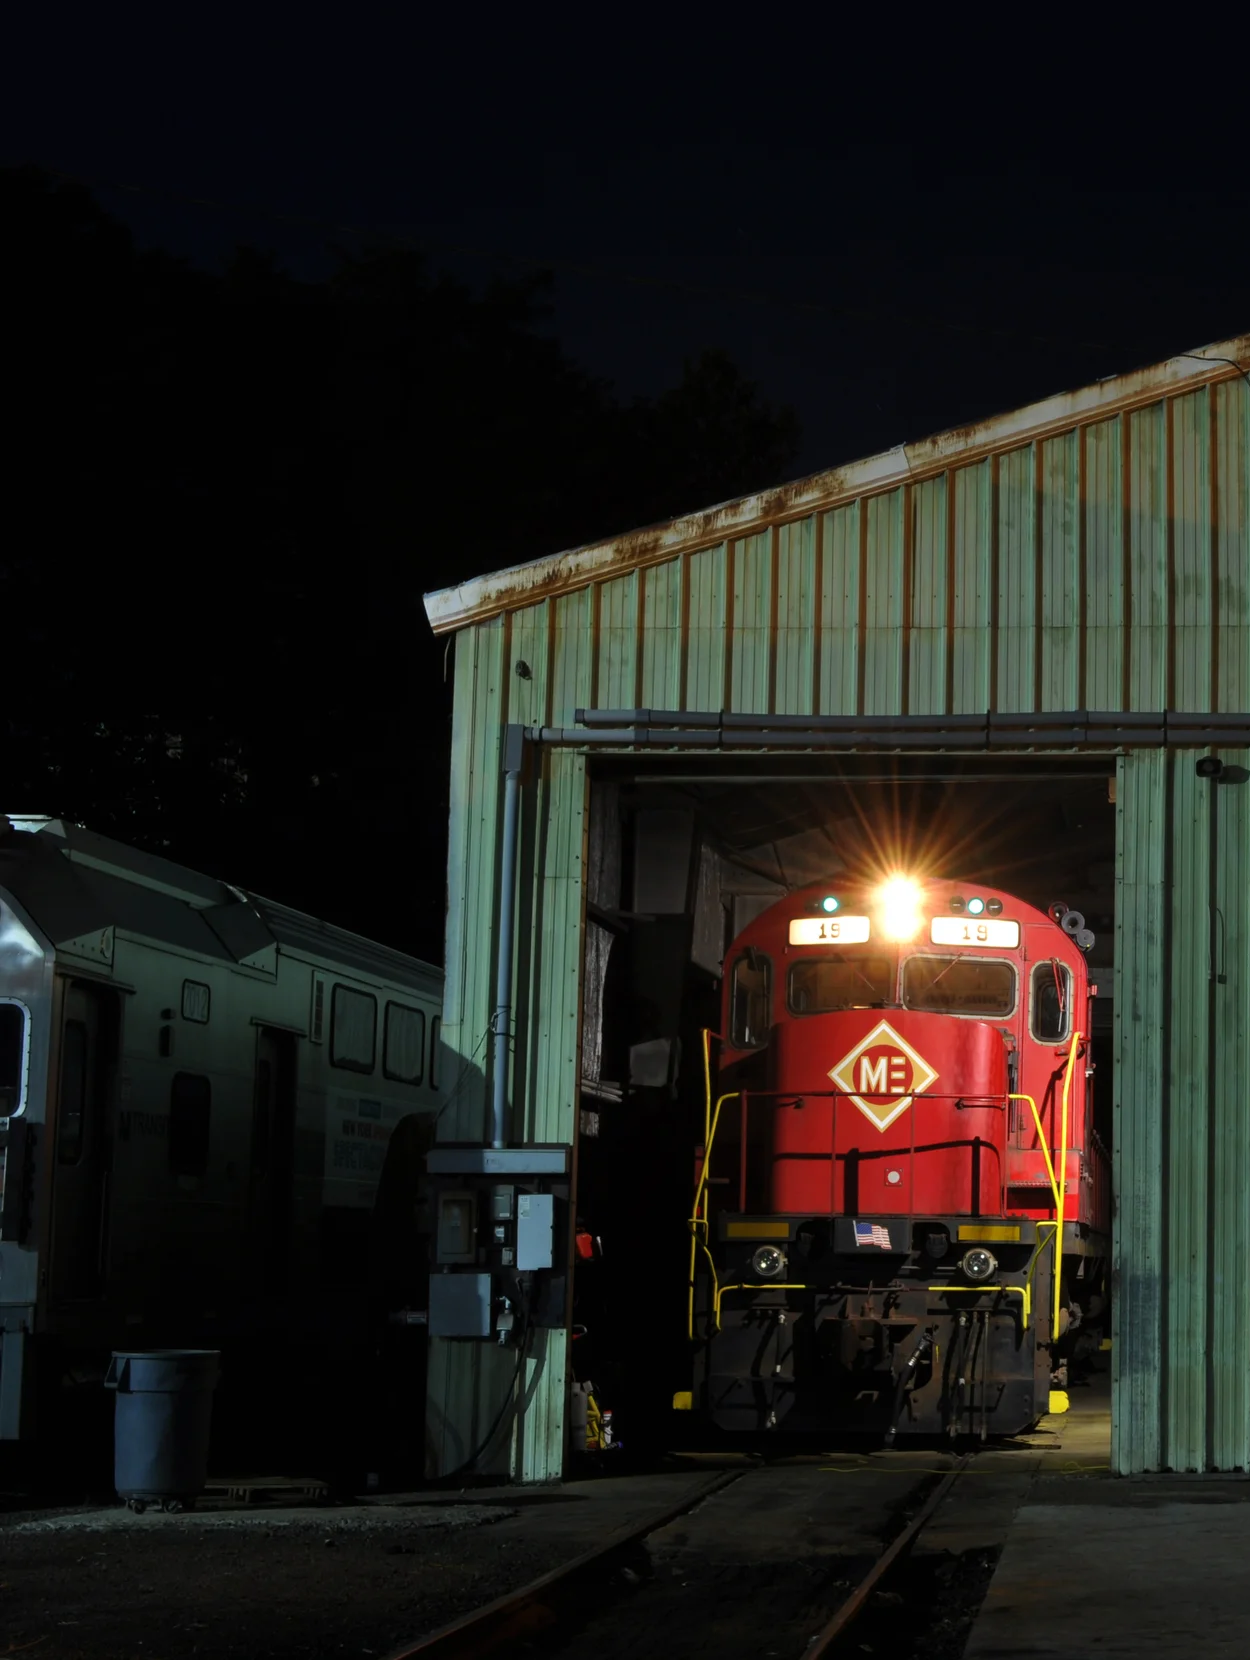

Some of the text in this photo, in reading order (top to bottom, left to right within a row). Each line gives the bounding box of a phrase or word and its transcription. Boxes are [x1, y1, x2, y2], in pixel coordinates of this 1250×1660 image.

[819, 922, 840, 939] 19
[962, 924, 988, 942] 19
[860, 1055, 906, 1093] ME
